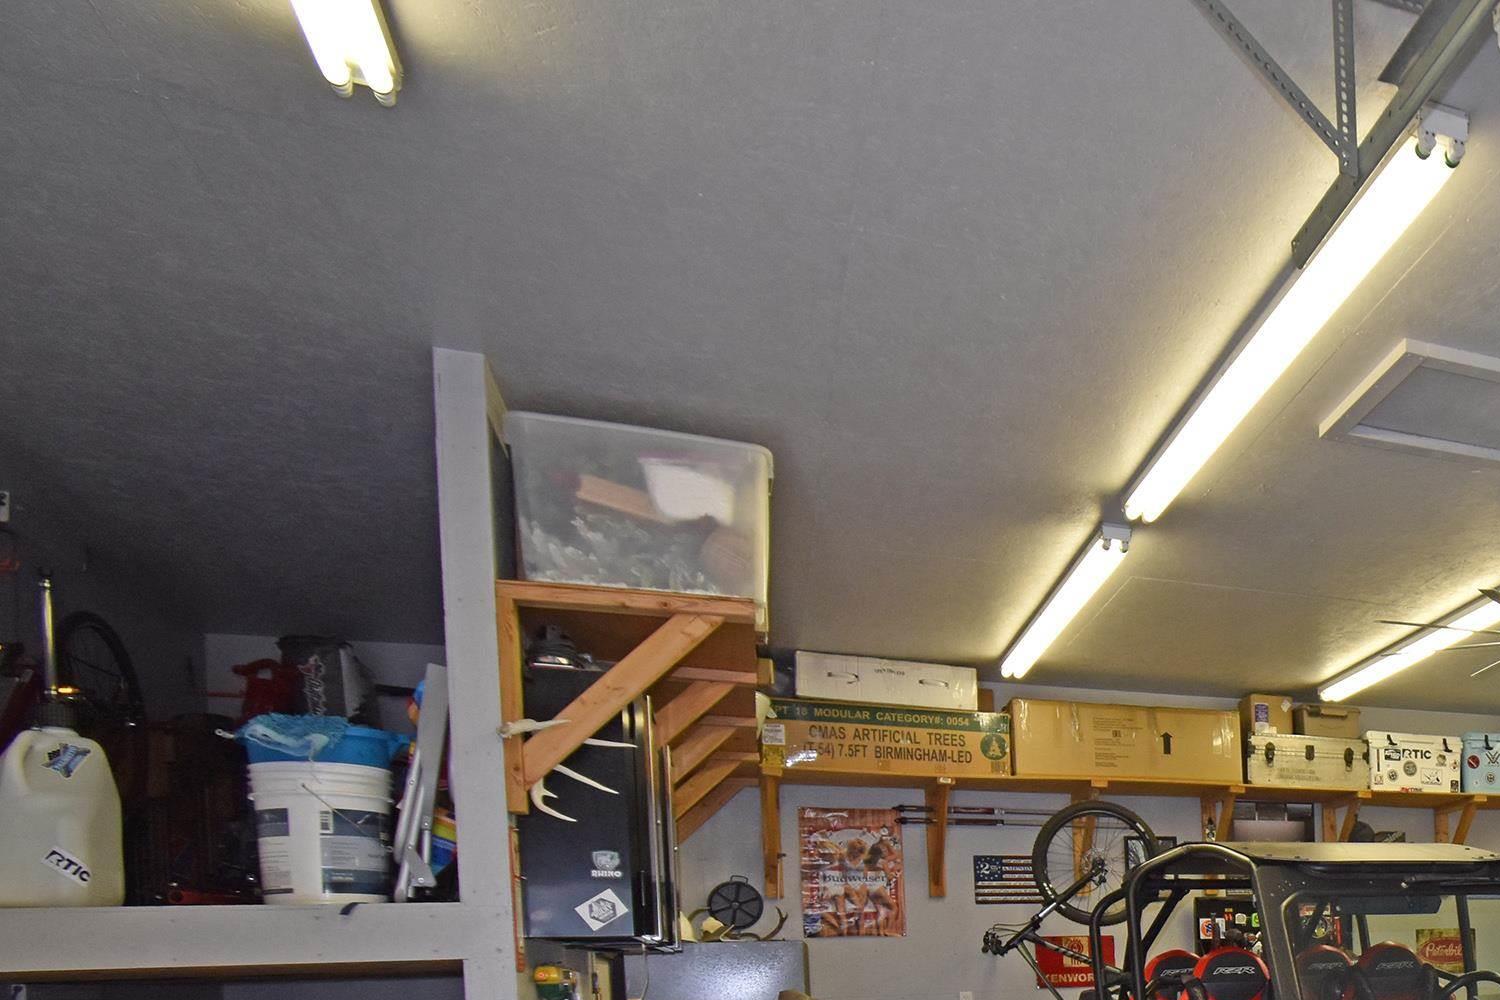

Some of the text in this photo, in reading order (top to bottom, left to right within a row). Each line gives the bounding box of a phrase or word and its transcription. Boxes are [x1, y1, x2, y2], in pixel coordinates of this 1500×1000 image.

[813, 707, 870, 720] MODULAR
[876, 711, 944, 726] CATEGORY#:
[946, 716, 970, 727] 0054
[808, 724, 966, 747] CMAS ARTIFICIAL TREES
[837, 743, 867, 760] 7.5FT
[875, 744, 973, 764] BIRMINGHAM-LED
[1402, 749, 1432, 759] RTIC
[45, 850, 91, 882] RTIC
[591, 869, 622, 878] RHINO
[823, 873, 886, 884] Budweiser
[1425, 942, 1464, 958] Peterbil
[1045, 973, 1096, 983] KENWOR
